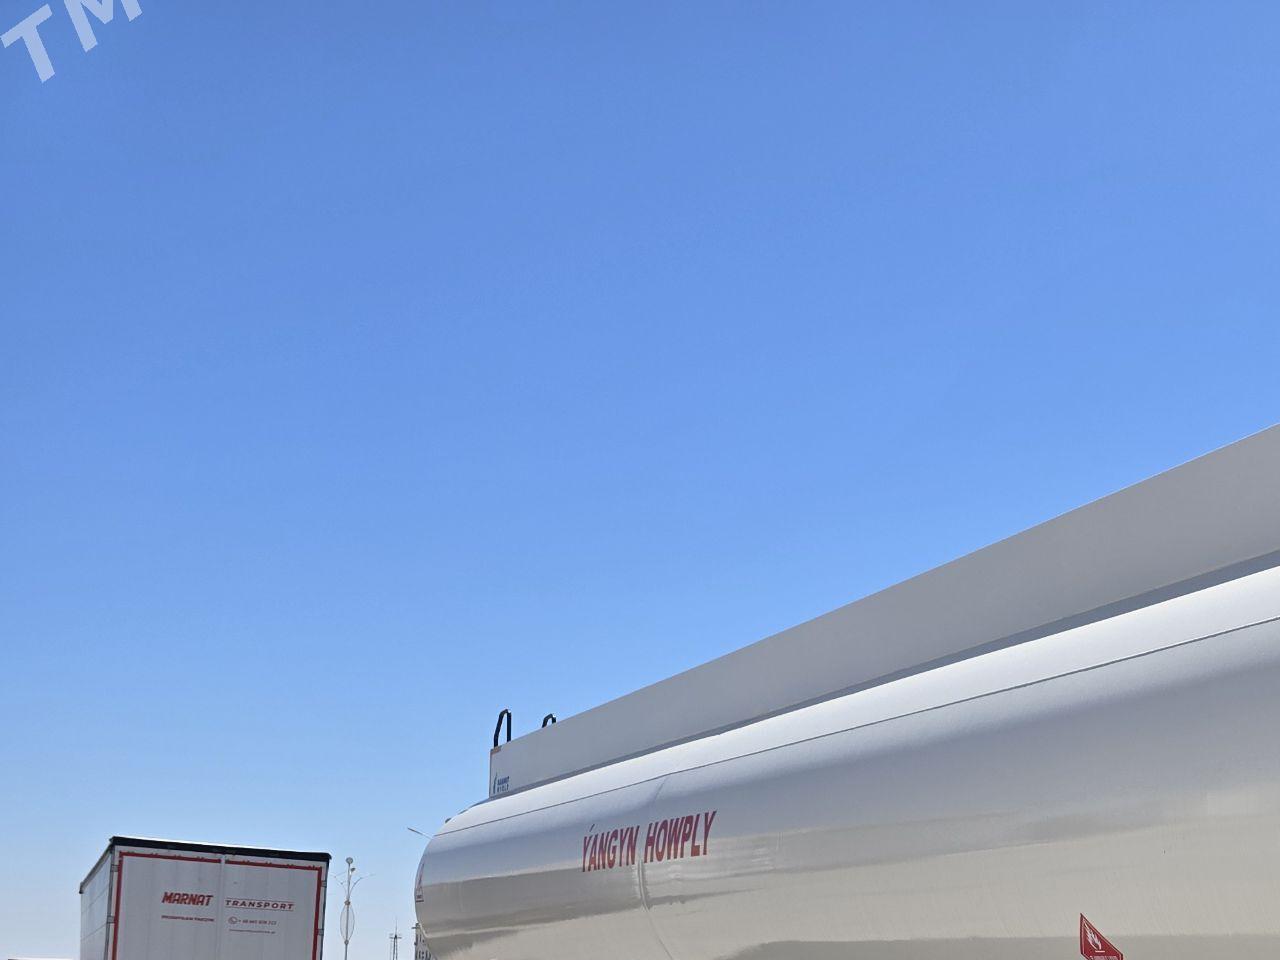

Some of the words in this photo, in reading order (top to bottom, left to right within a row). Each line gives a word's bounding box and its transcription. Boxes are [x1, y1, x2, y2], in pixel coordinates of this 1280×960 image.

[582, 823, 640, 873] ÝANGYN
[643, 810, 718, 864] HOWPLY
[161, 891, 214, 907] MARNAT
[225, 899, 295, 910] TRANSPORT
